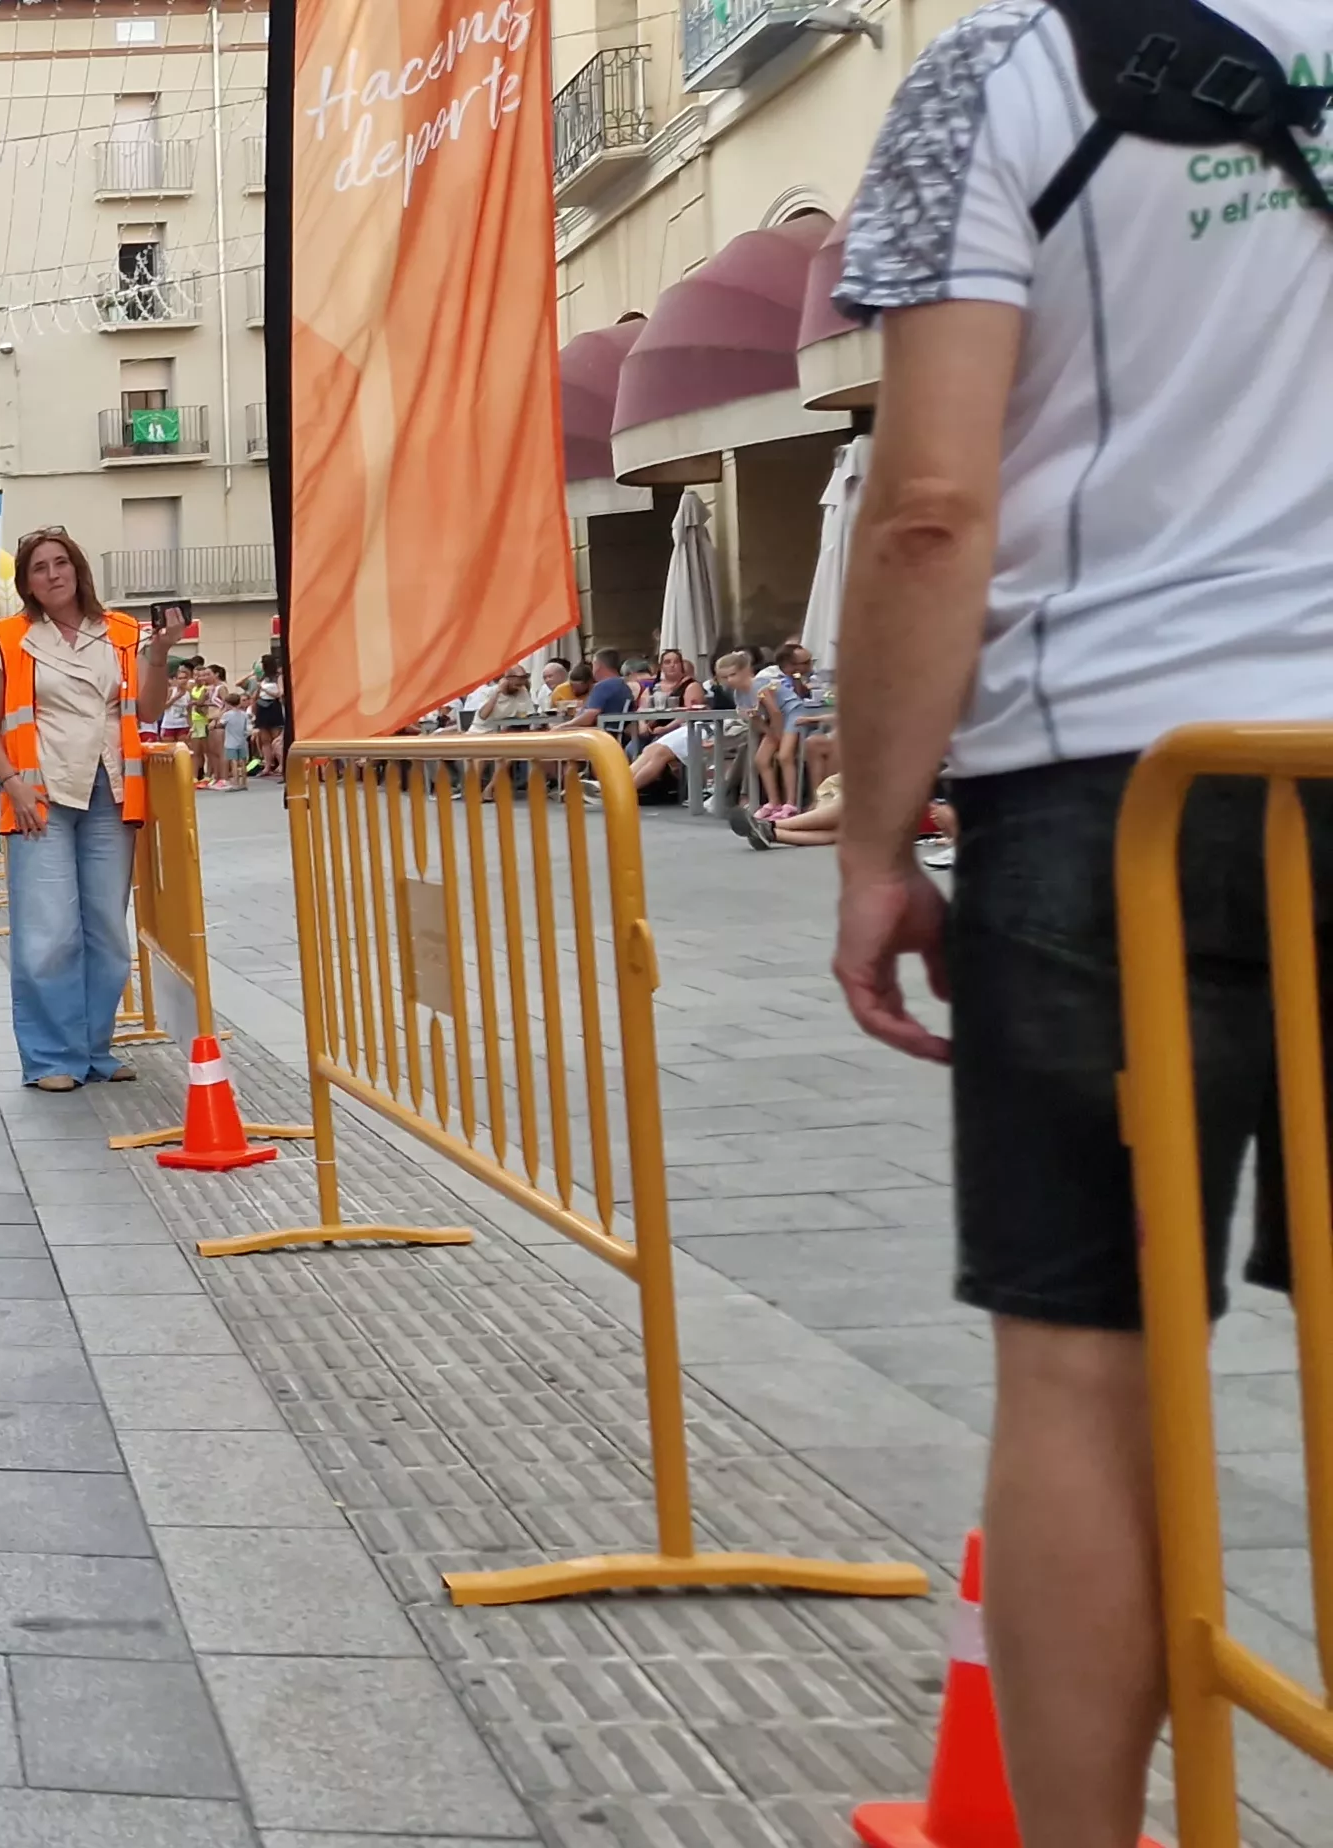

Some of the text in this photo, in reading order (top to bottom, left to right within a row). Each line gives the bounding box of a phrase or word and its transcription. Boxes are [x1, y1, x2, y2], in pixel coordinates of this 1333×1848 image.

[306, 0, 535, 140] Hacemos
[335, 56, 521, 208] deporte
[1188, 153, 1256, 183] Con
[1190, 208, 1211, 240] y
[1222, 192, 1250, 223] el
